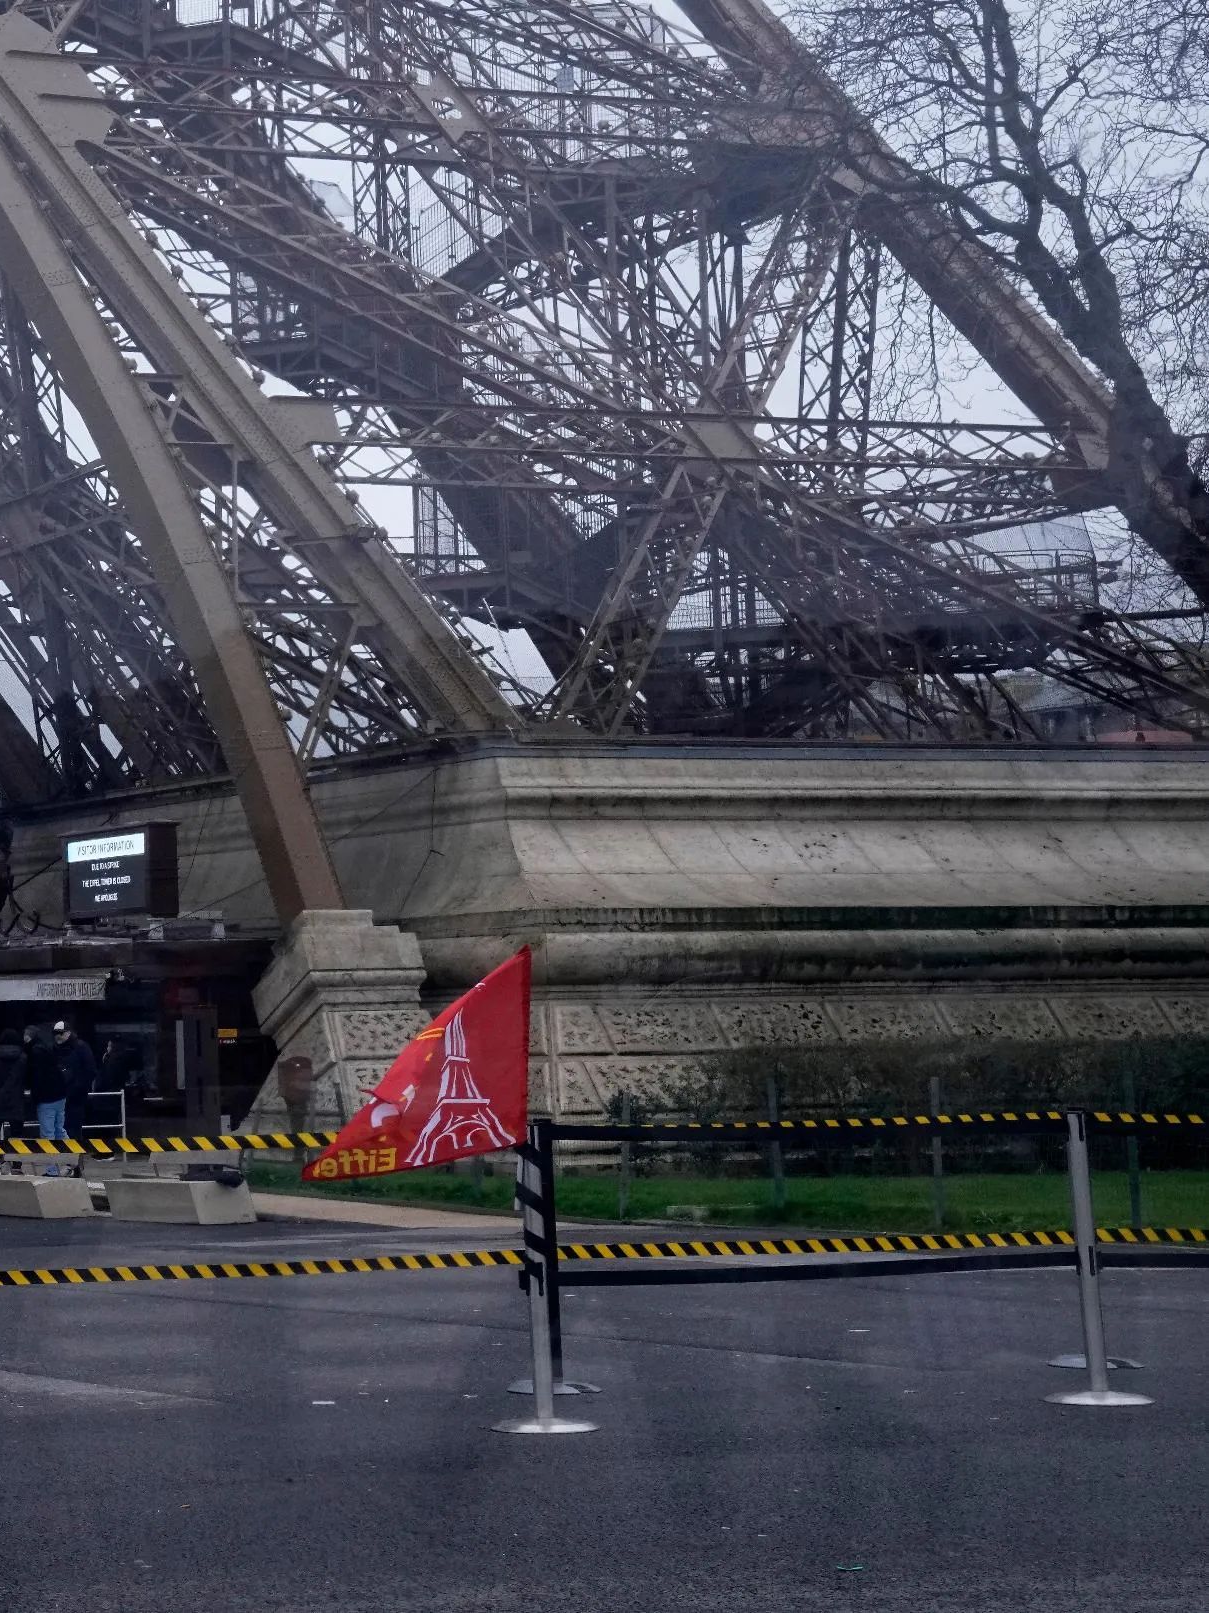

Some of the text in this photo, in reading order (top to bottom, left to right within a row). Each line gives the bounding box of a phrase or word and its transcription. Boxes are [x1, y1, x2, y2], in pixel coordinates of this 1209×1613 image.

[77, 840, 135, 856] VISITOR INFORMATION
[37, 983, 77, 997] INFORMATION
